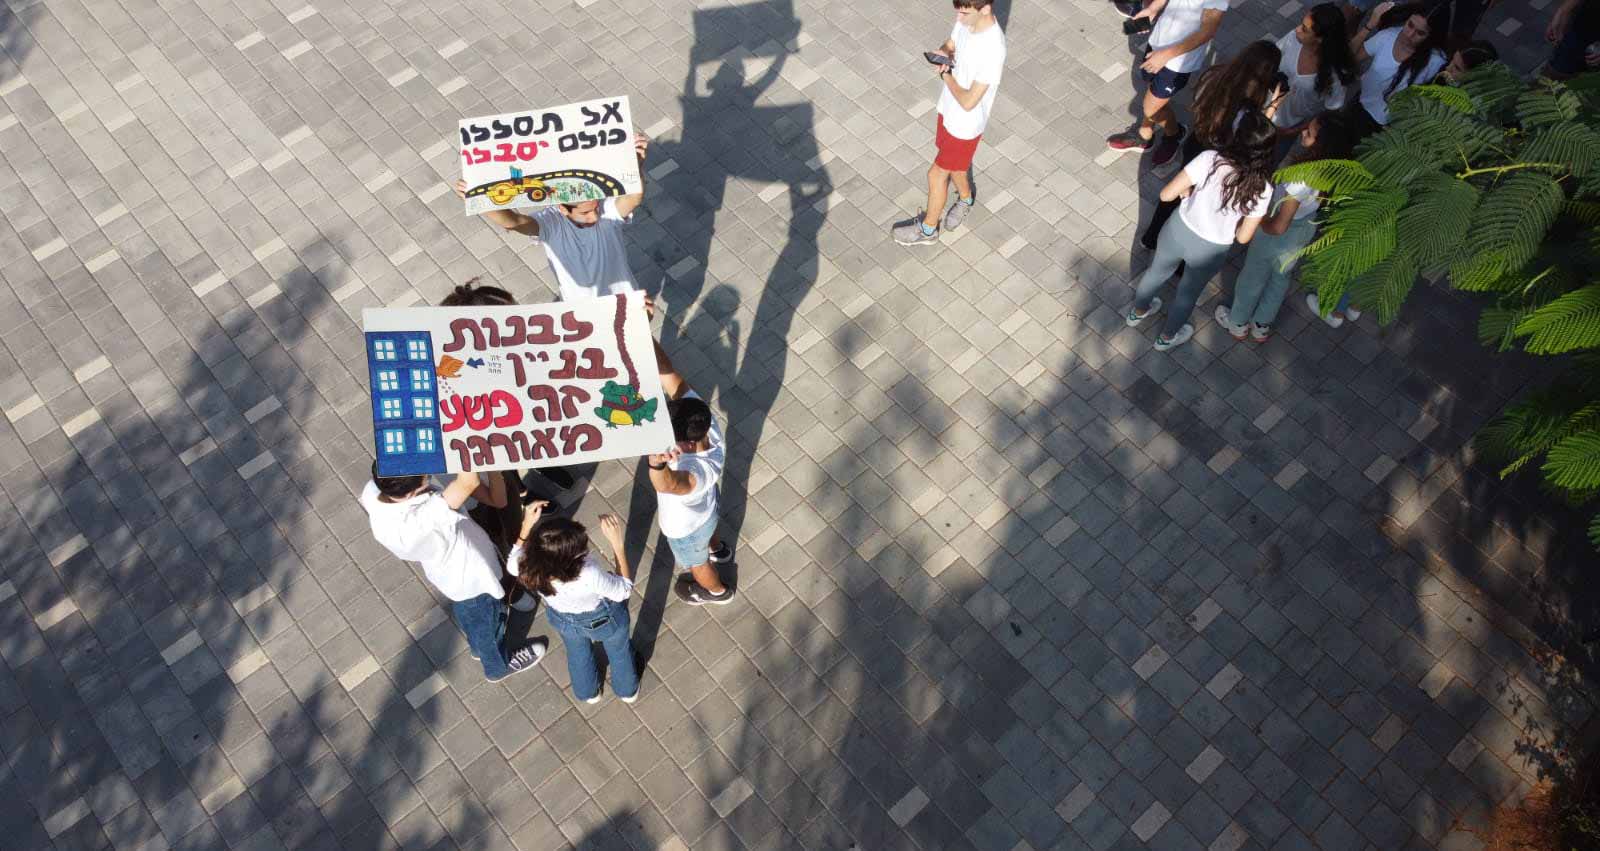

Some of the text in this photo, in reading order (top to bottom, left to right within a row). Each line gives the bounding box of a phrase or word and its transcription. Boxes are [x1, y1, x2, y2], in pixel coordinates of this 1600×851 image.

[460, 101, 623, 146] אל תסללו
[460, 128, 627, 166] כולם יסבלו
[443, 310, 594, 353] לבנות
[506, 347, 618, 387] בניין
[440, 384, 592, 433] זה פשע
[450, 423, 603, 472] מאורגן
